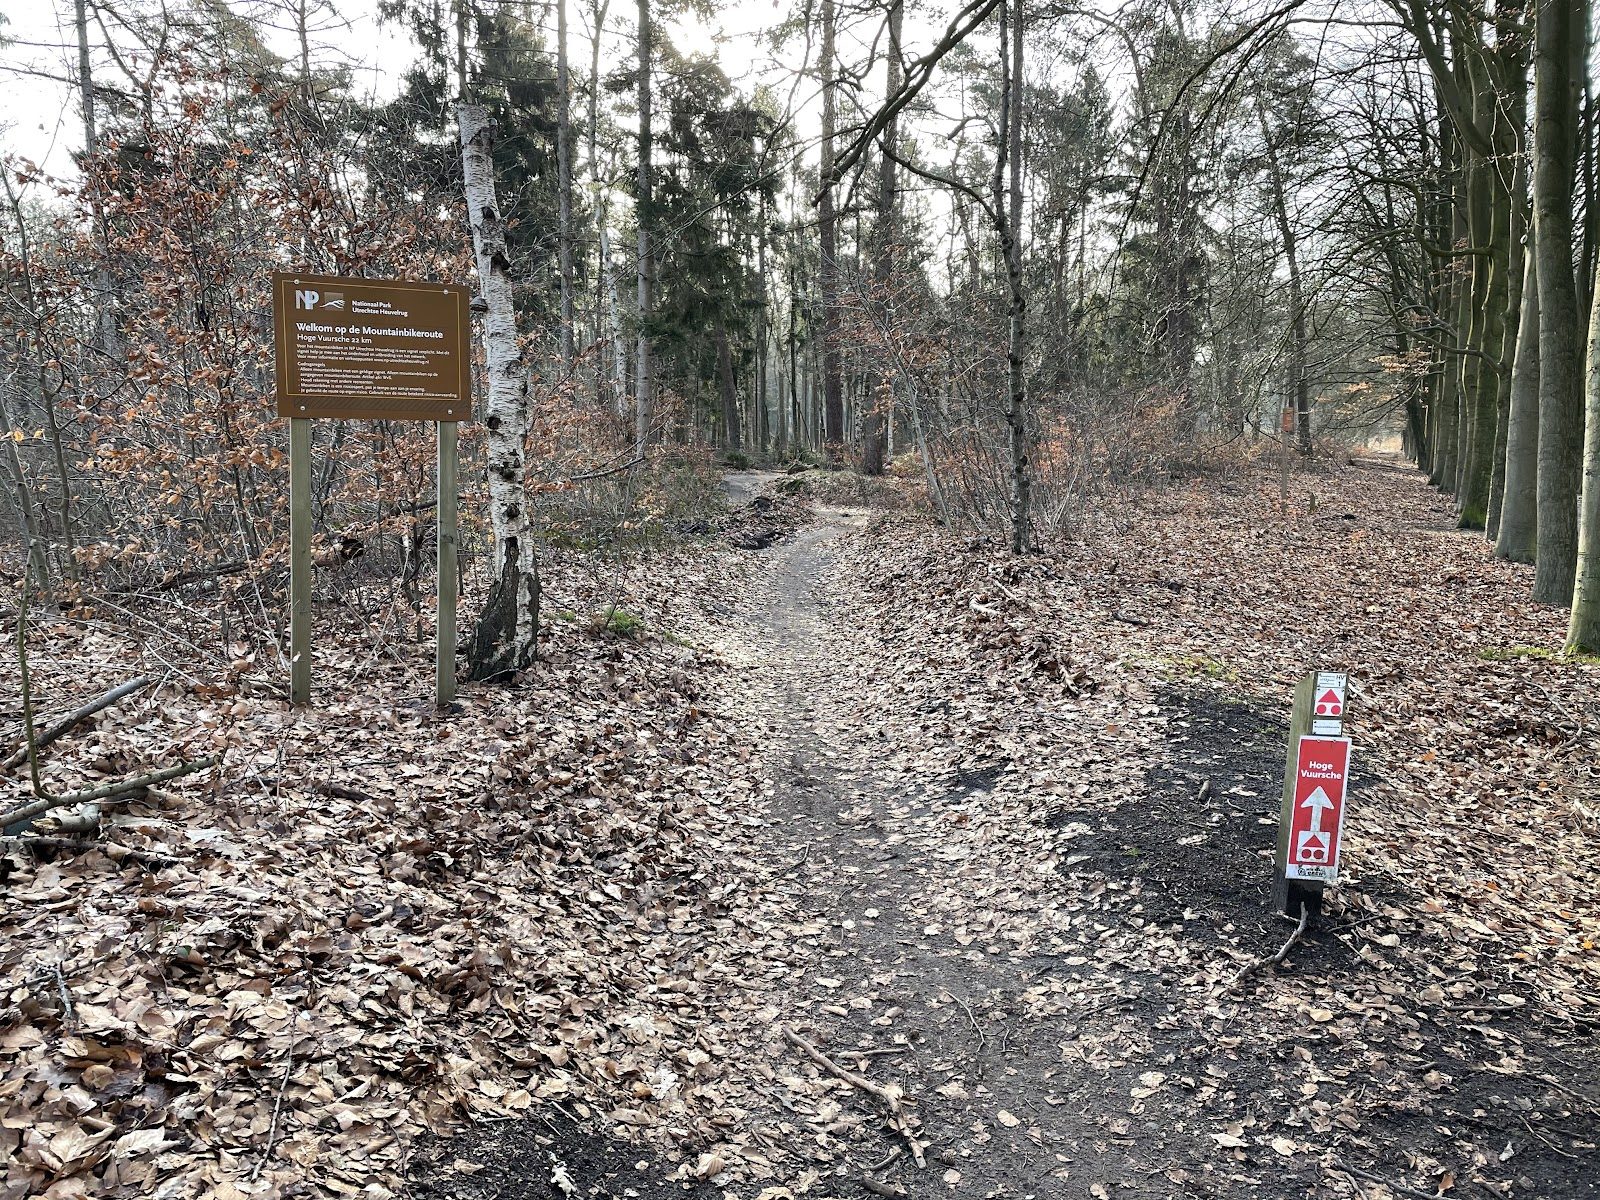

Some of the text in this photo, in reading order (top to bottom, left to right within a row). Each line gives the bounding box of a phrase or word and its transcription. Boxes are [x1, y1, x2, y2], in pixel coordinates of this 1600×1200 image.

[295, 290, 320, 310] NP
[380, 309, 408, 317] Heuvelrug
[296, 322, 444, 338] Welkom op de Mountainbikeroute
[297, 334, 316, 342] Hoge
[1309, 761, 1333, 771] Hoge
[1301, 770, 1342, 780] Vuursche
